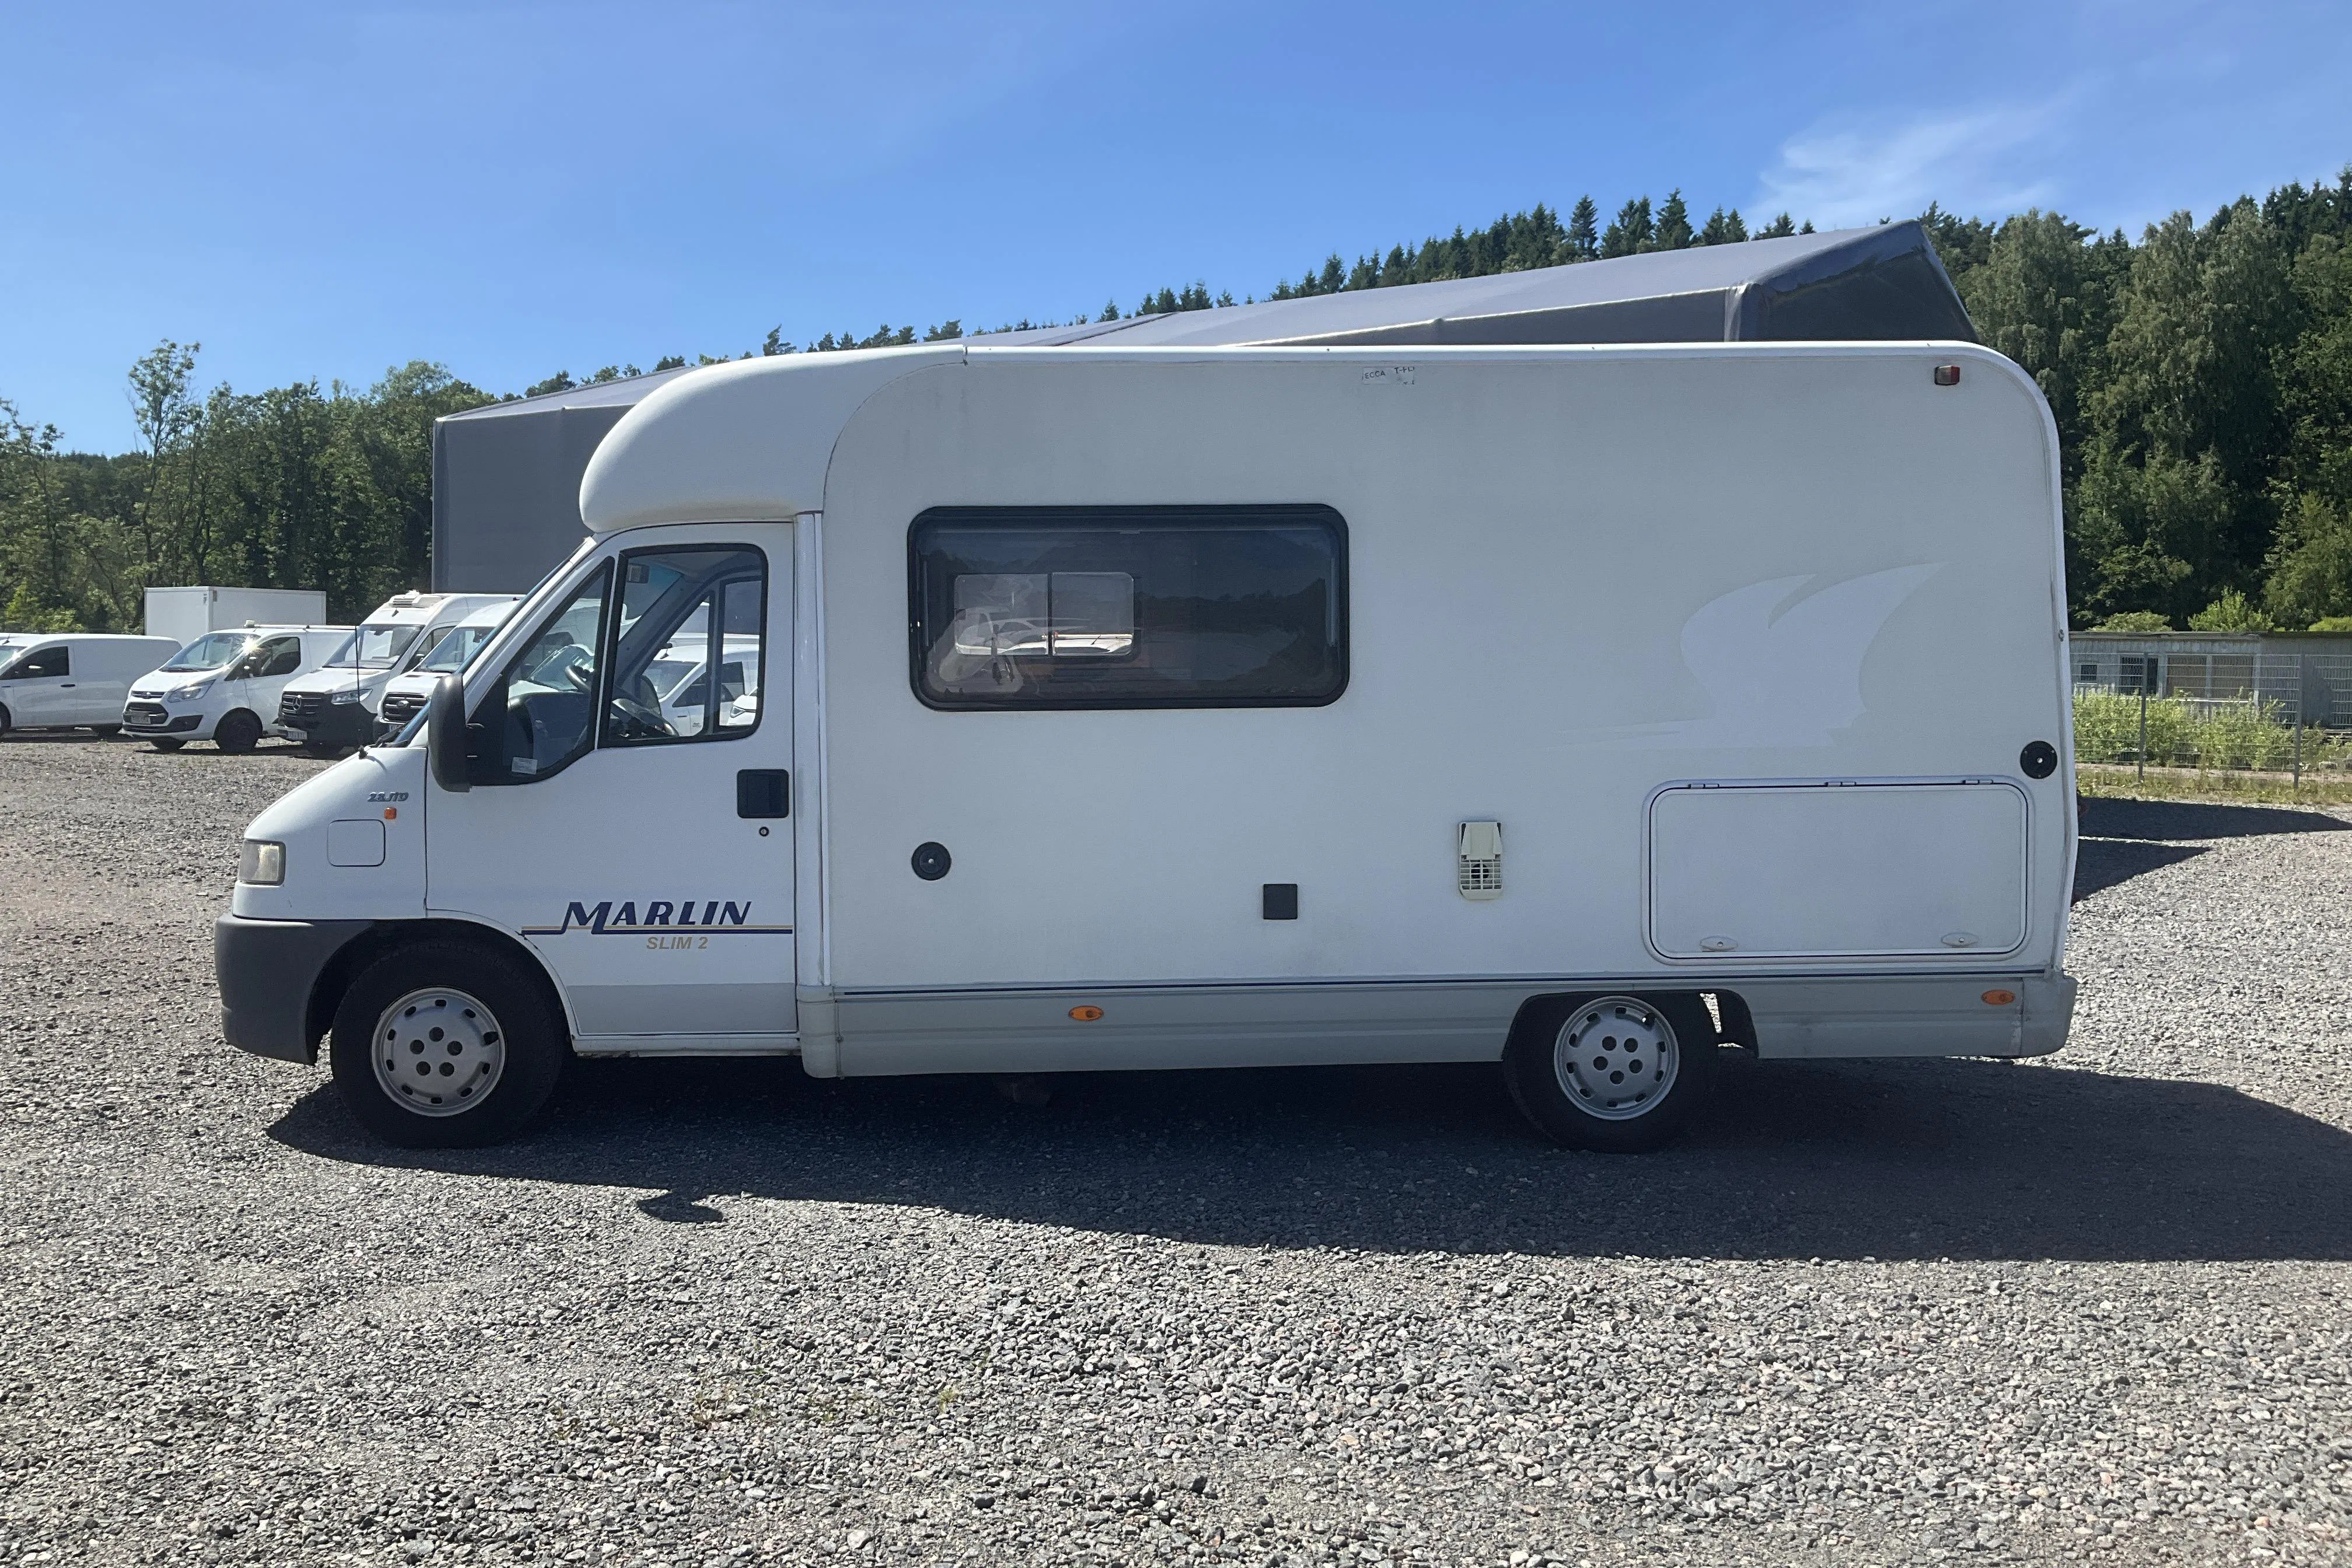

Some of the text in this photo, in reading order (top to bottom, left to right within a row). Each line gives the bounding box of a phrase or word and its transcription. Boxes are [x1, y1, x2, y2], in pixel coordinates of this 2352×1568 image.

[562, 901, 752, 935] MARLIN
[646, 936, 708, 950] SLIM 2
